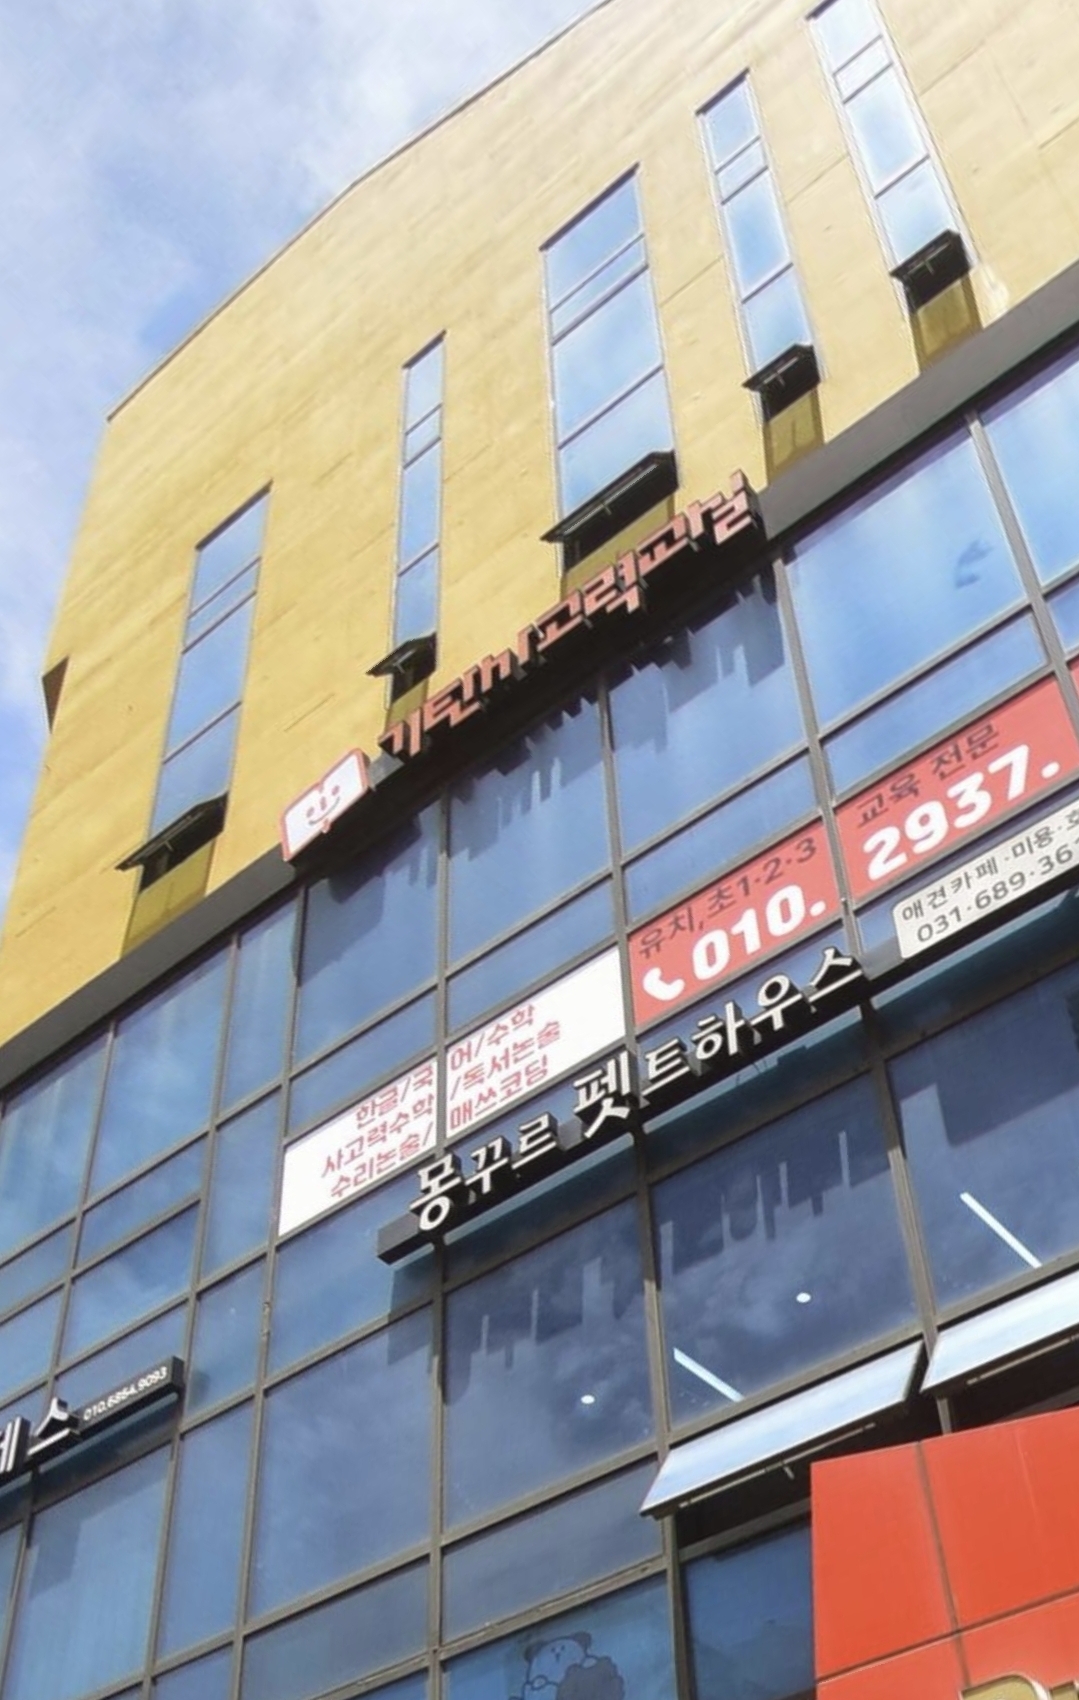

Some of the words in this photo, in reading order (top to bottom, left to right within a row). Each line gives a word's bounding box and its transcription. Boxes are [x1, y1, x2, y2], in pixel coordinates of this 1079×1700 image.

[856, 772, 921, 829] 교육
[929, 722, 999, 782] 전문
[916, 837, 1079, 943] 031·689·36
